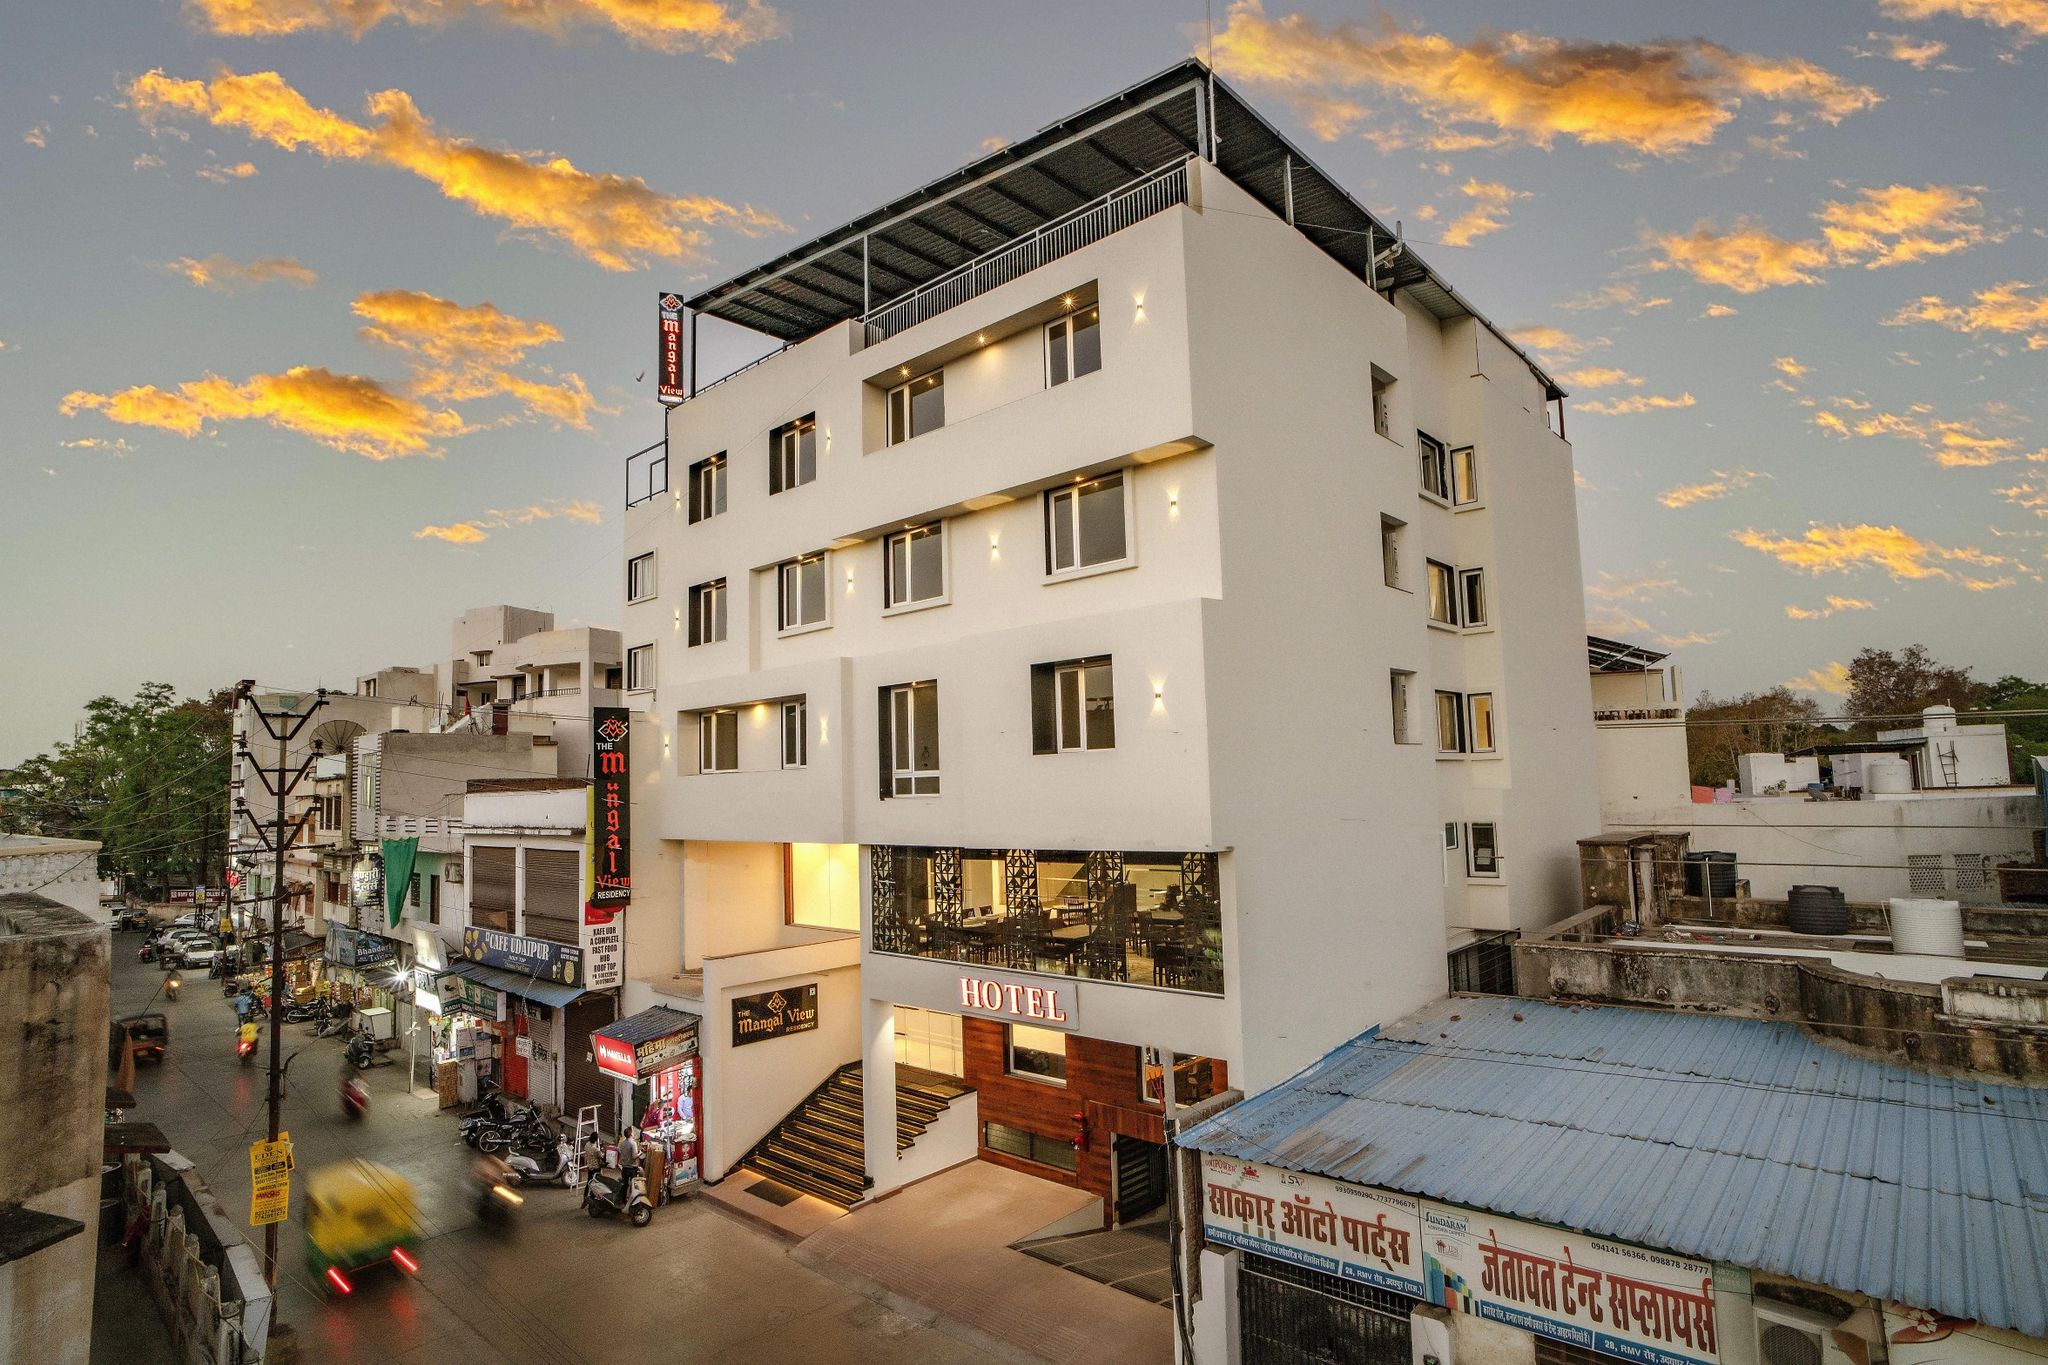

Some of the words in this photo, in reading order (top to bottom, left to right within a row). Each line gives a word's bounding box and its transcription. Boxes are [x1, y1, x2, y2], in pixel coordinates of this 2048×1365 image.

[661, 311, 678, 320] THE
[660, 385, 683, 396] View
[596, 742, 613, 750] THE
[597, 875, 630, 888] View
[597, 889, 630, 899] RESIDENCY
[590, 938, 594, 946] A
[594, 935, 619, 945] COMPLETE
[357, 943, 392, 956] Bhandari
[489, 933, 509, 952] CAFE
[511, 937, 550, 961] UDAIPUR
[592, 946, 604, 955] FAST
[604, 944, 618, 953] FOOD
[600, 953, 611, 962] HUB
[594, 964, 606, 973] ROOF
[607, 962, 617, 971] TOP
[960, 978, 1067, 1021] HOTEL
[737, 1009, 751, 1018] THE
[738, 1012, 784, 1034] Mangal
[787, 1008, 815, 1023] View
[786, 1022, 815, 1032] RESIDENCY
[606, 1048, 632, 1064] HAVELLS
[254, 1150, 283, 1160] EDEN
[1425, 1211, 1467, 1232] SUNDARAM
[1207, 1183, 1275, 1230] साकार
[1281, 1193, 1338, 1247] ऑटो
[1341, 1213, 1411, 1273] पार्ट्स
[1591, 1241, 1619, 1255] 094141
[1650, 1255, 1681, 1269] 098878
[1683, 1263, 1709, 1276] 28777
[1357, 1270, 1372, 1280] RMV
[1478, 1229, 1557, 1311] जेतावत
[1559, 1245, 1604, 1323] टेन्ट
[1606, 1277, 1717, 1355] सप्लायर्स
[1620, 1344, 1641, 1356] RMV
